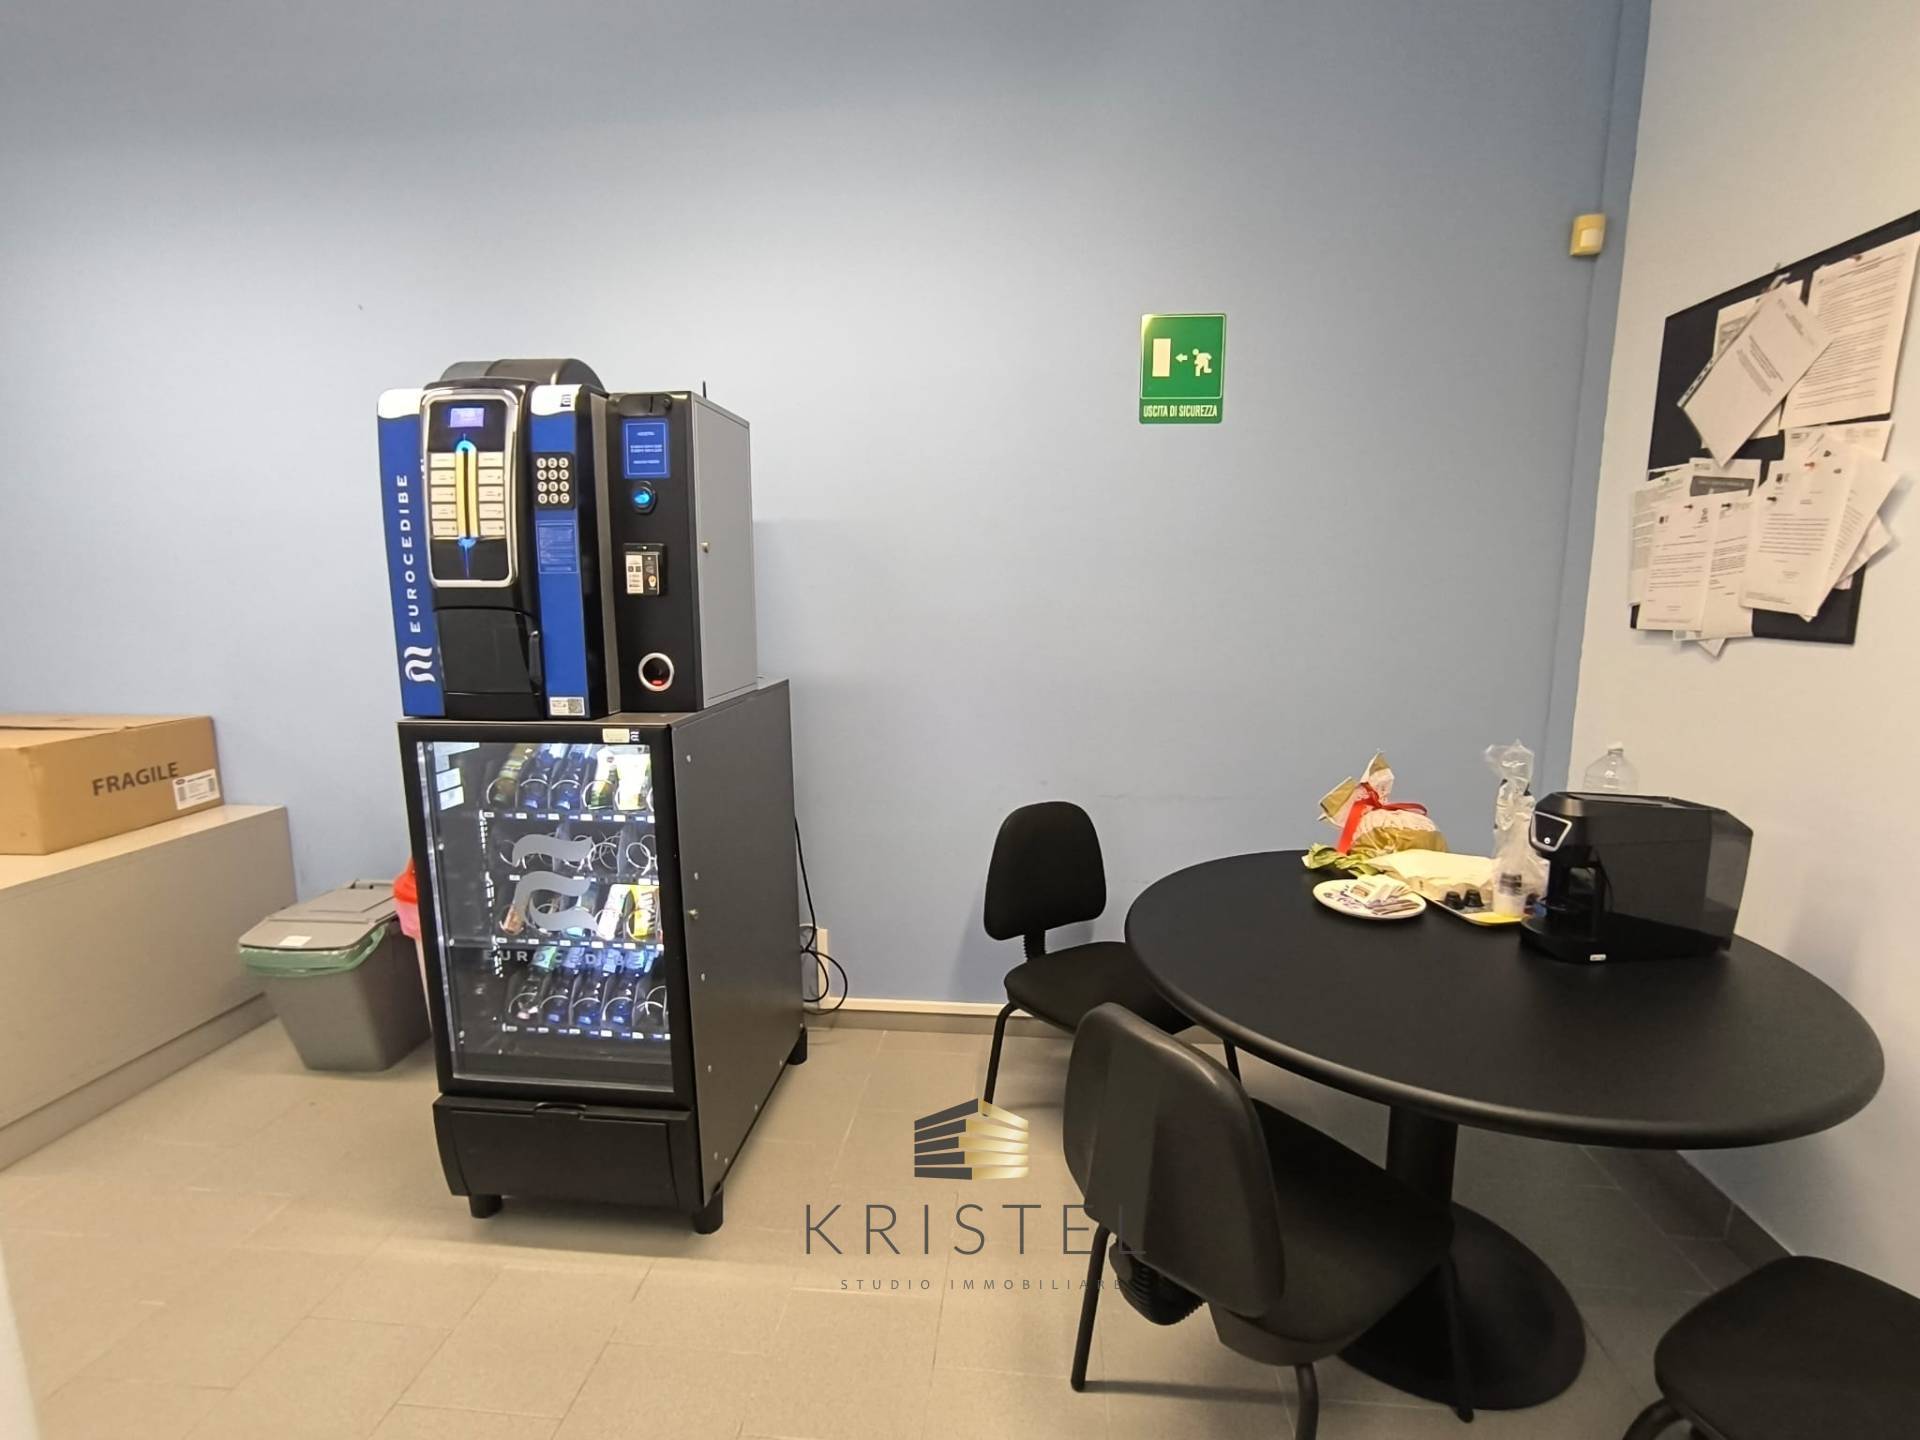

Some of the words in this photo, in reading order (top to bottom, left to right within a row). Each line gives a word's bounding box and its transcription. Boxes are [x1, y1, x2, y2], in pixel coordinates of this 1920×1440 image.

[1143, 405, 1168, 417] USCITA
[1169, 405, 1178, 417] DI
[1178, 404, 1218, 417] SICUREZZA
[397, 475, 421, 633] EUROCEDIBE
[92, 761, 179, 796] FRAGILE
